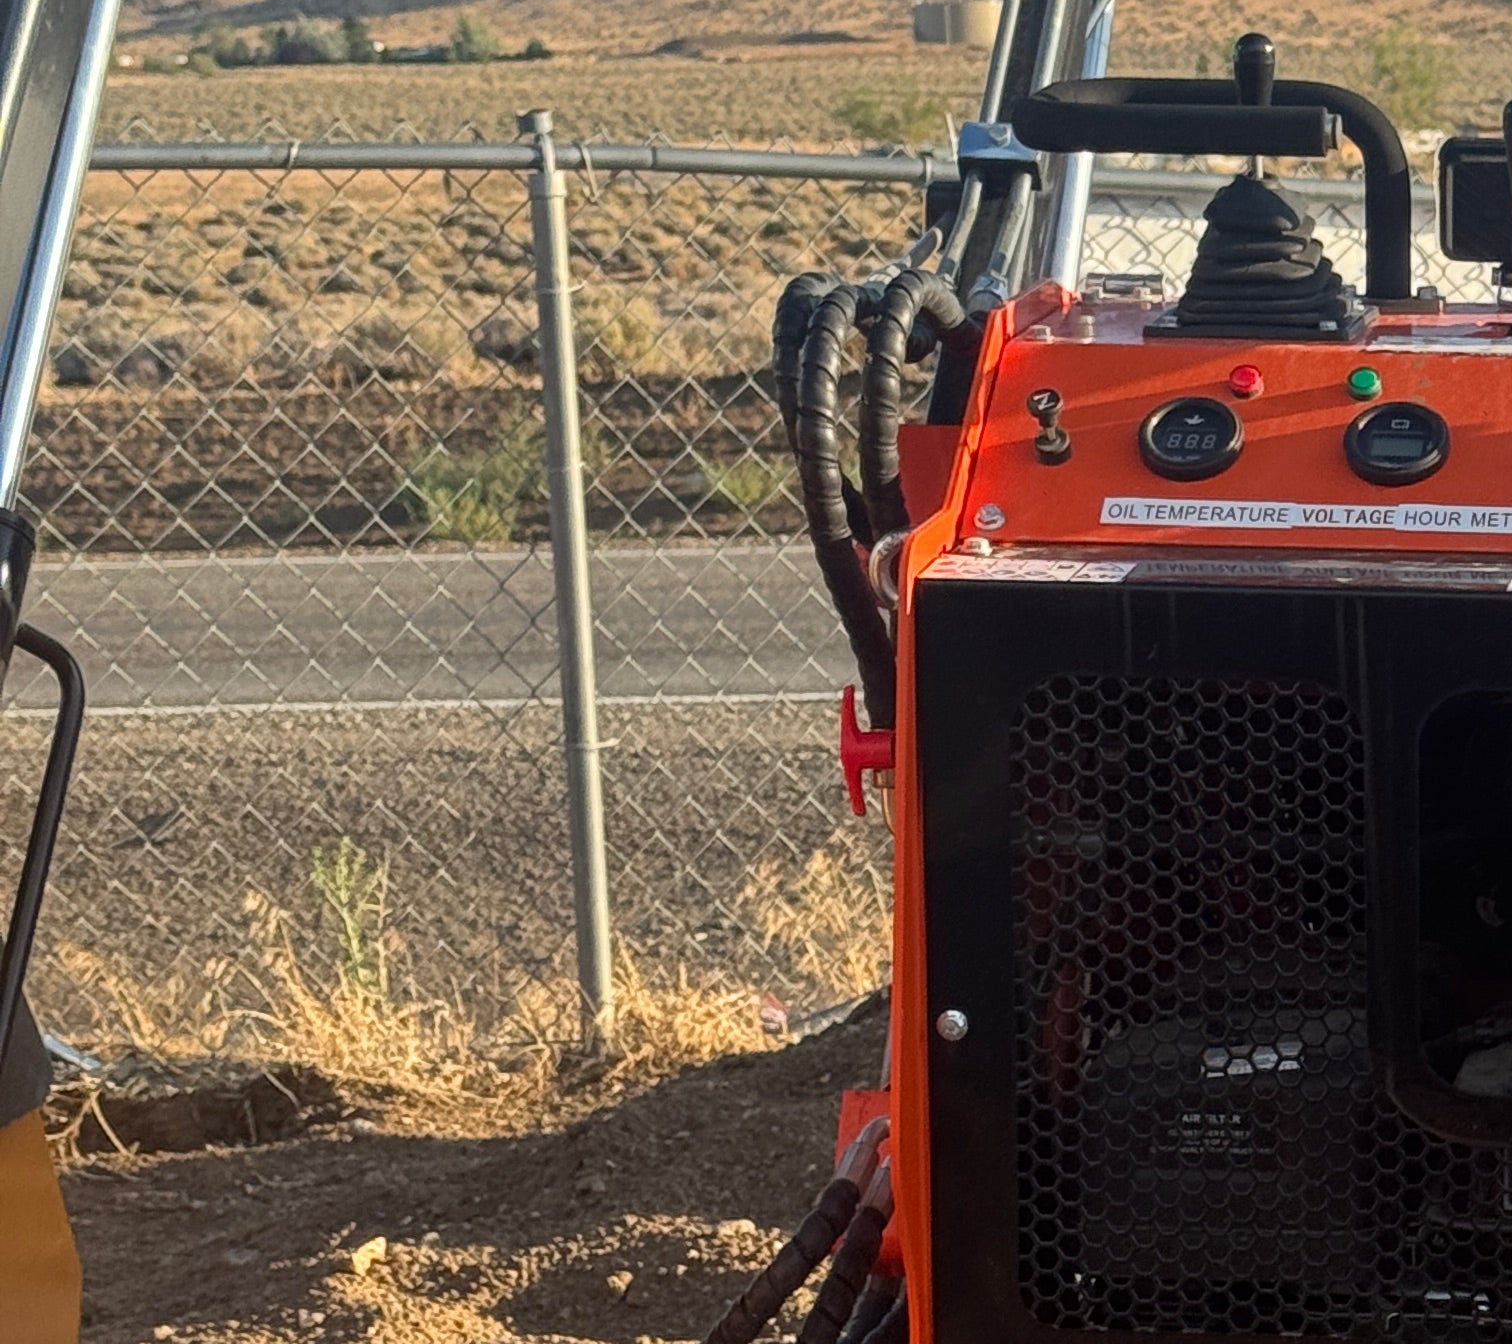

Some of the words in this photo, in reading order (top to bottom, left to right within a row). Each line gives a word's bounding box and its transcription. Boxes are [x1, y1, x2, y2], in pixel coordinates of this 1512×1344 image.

[1107, 503, 1139, 520] OIL
[1143, 504, 1290, 523] TEMPERATURE
[1302, 508, 1396, 525] VOLTAGE
[1403, 510, 1462, 527] HOUR
[1181, 1113, 1201, 1124] AIR
